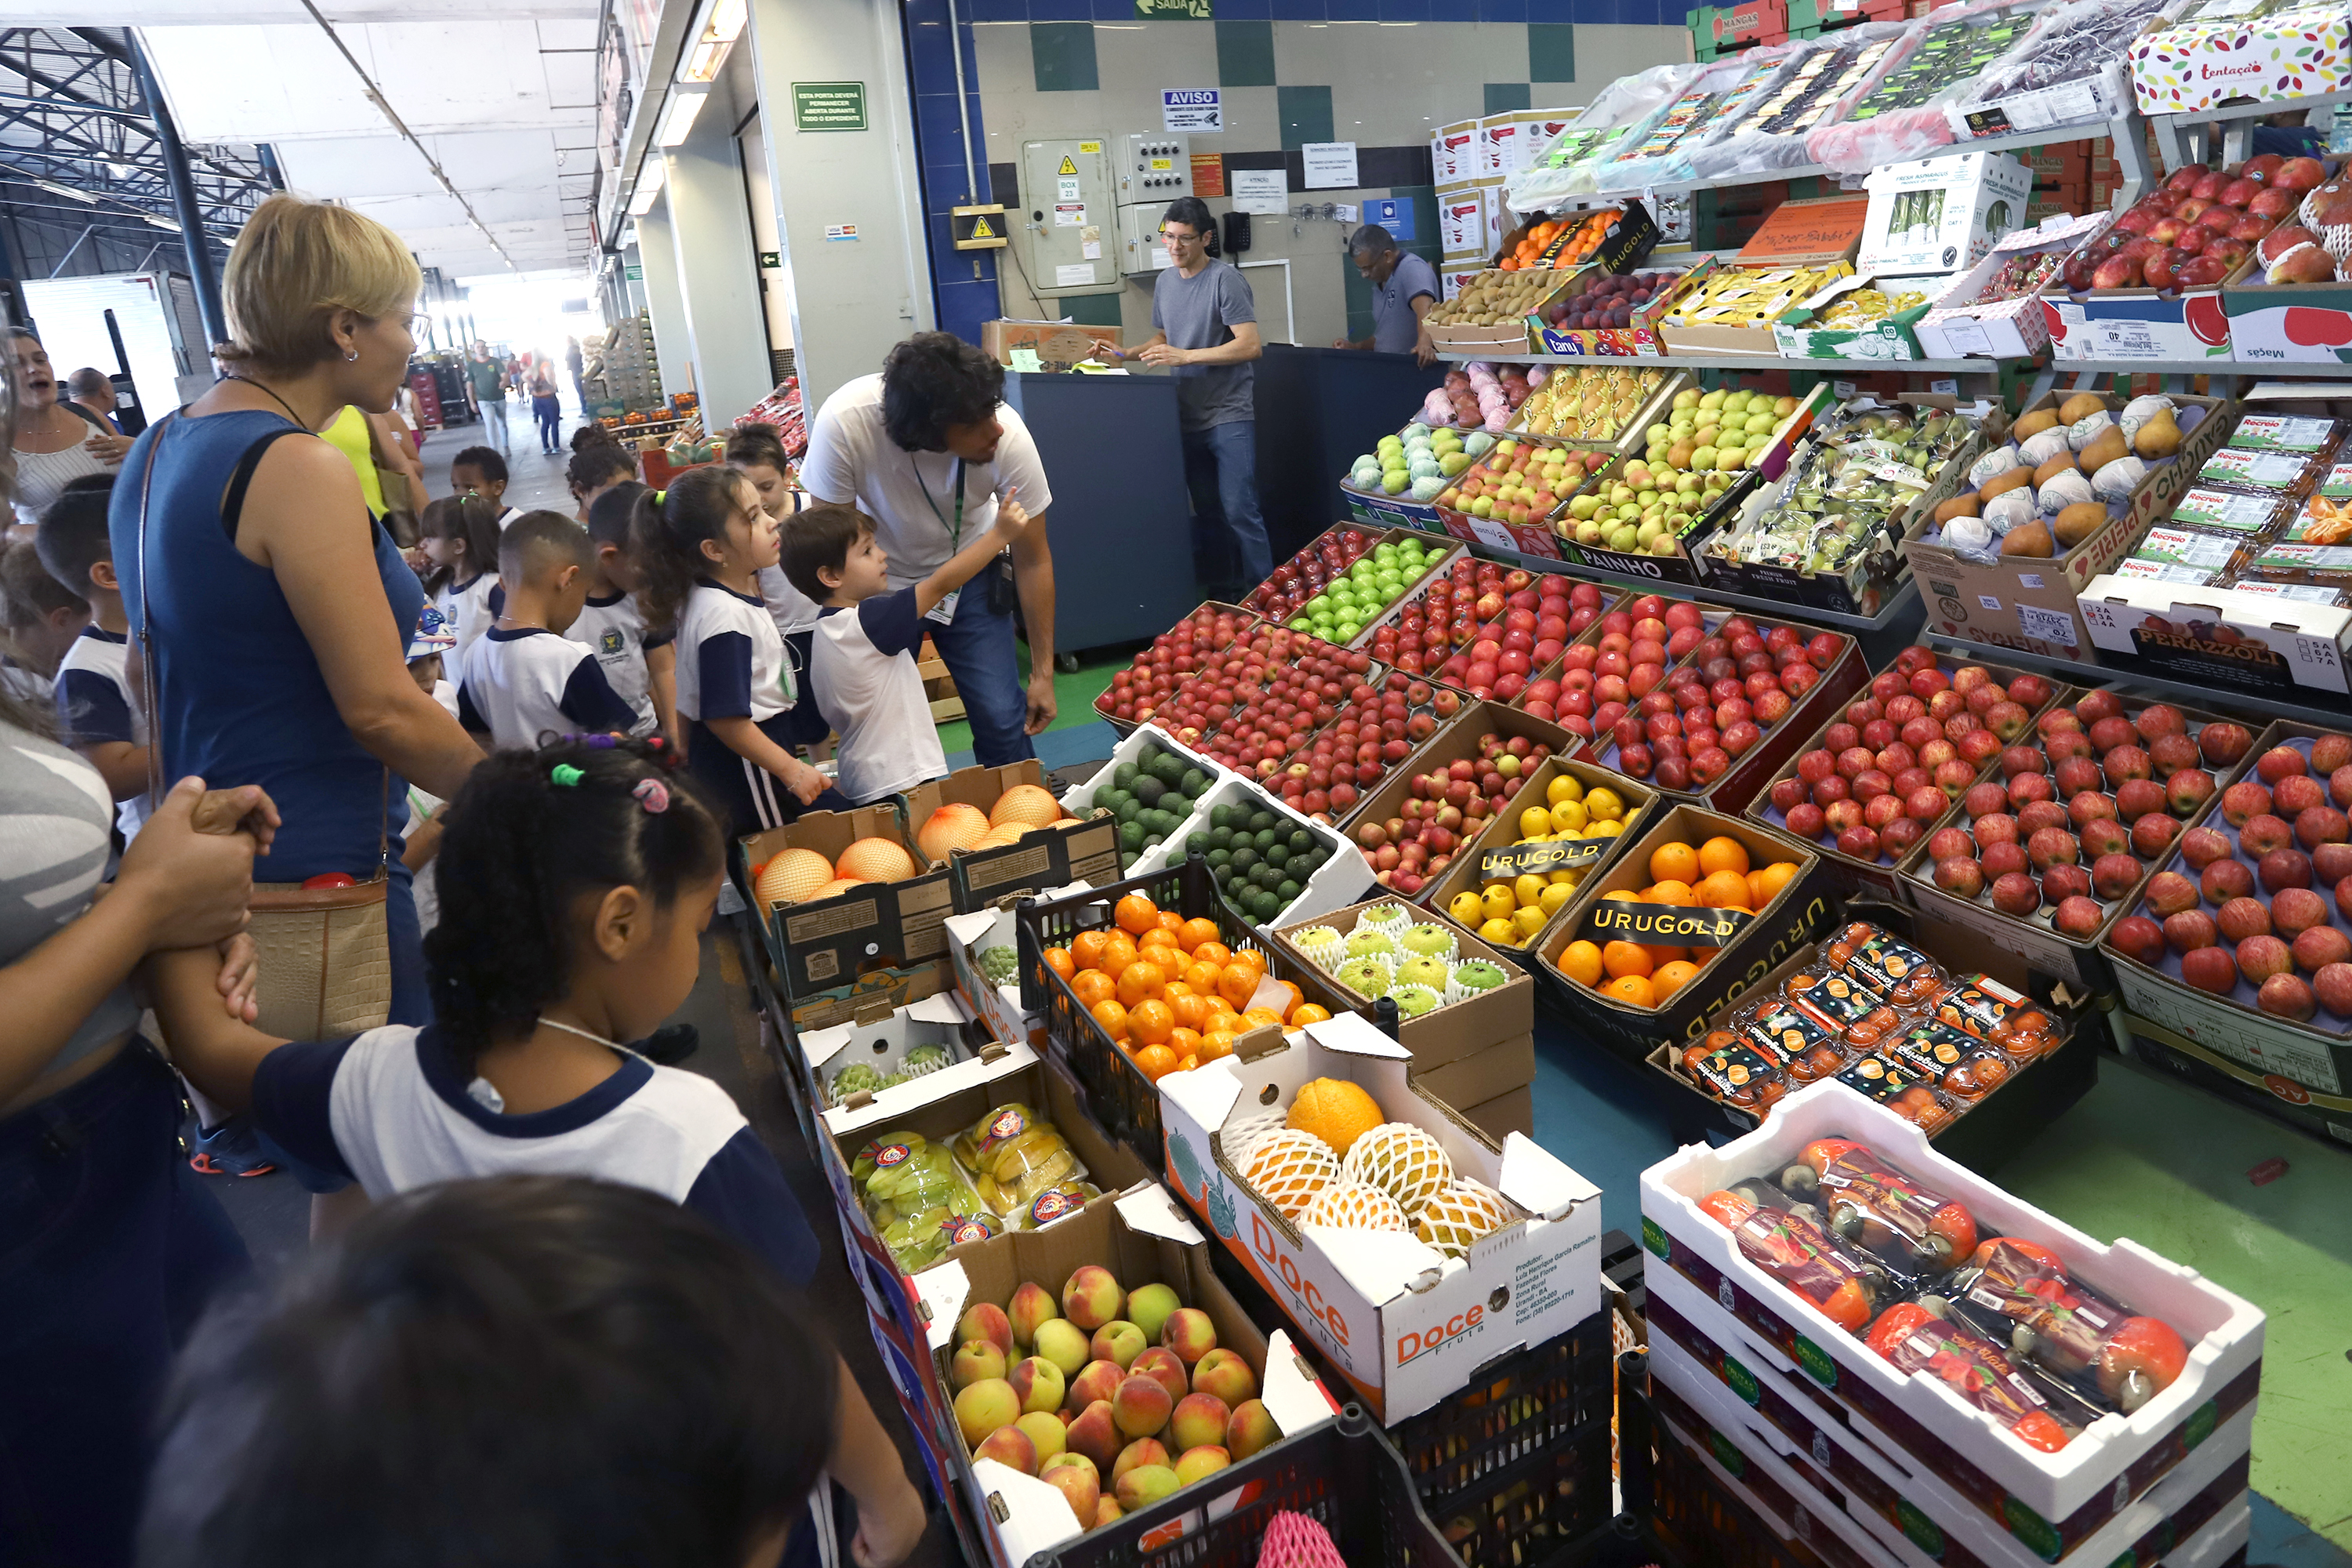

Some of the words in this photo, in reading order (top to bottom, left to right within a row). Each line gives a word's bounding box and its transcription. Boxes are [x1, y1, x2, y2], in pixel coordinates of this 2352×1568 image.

[1723, 12, 1759, 27] MANGAS
[1171, 92, 1213, 104] AVISO
[1983, 178, 1999, 189] FRESH
[1999, 184, 2025, 198] ASPARAGUS
[1549, 339, 1580, 355] tany
[2247, 348, 2284, 358] Maçãs
[2243, 419, 2279, 427] Recreio
[2216, 452, 2251, 462] Recreio
[2188, 493, 2223, 503] Recreio
[1474, 527, 1496, 537] frusan
[2151, 532, 2185, 543] Recreio
[1579, 549, 1662, 578] PAINHO
[2123, 562, 2158, 573] Recreio
[2237, 584, 2277, 593] Recreio
[2136, 628, 2279, 666] PERAZZOLI
[1481, 844, 1599, 871] URUGOLD
[1594, 908, 1735, 936] URUGOLD
[1686, 897, 1825, 1040] URUGOLD
[1850, 956, 1895, 989] Tangerina
[1950, 995, 1998, 1024] Tangerina
[1748, 1026, 1791, 1065] Tangerina
[1873, 1052, 1921, 1078] Tangerina
[1897, 1045, 1945, 1073] Tangerina
[1696, 1062, 1735, 1097] Tangerina
[2275, 1085, 2303, 1100] AC
[1516, 1269, 1528, 1282] Luiz
[1529, 1258, 1553, 1275] Henrique
[1554, 1247, 1572, 1261] Garcia
[1573, 1235, 1596, 1251] Ramalho
[1516, 1254, 1543, 1272] Produtor:
[1251, 1209, 1349, 1346] Doce
[1516, 1275, 1539, 1290] Fazenda
[1540, 1265, 1557, 1278] Flores
[1516, 1289, 1530, 1300] Zona
[1531, 1279, 1546, 1292] Rural
[1516, 1294, 1535, 1308] Urandi
[1539, 1287, 1548, 1296] BA
[1516, 1305, 1529, 1317] Cep:
[1530, 1290, 1557, 1309] 46350-000
[1516, 1313, 1531, 1325] Fone:
[1295, 1299, 1352, 1372] Fruta
[1397, 1304, 1483, 1364] Doce
[1436, 1325, 1484, 1356] Fruta
